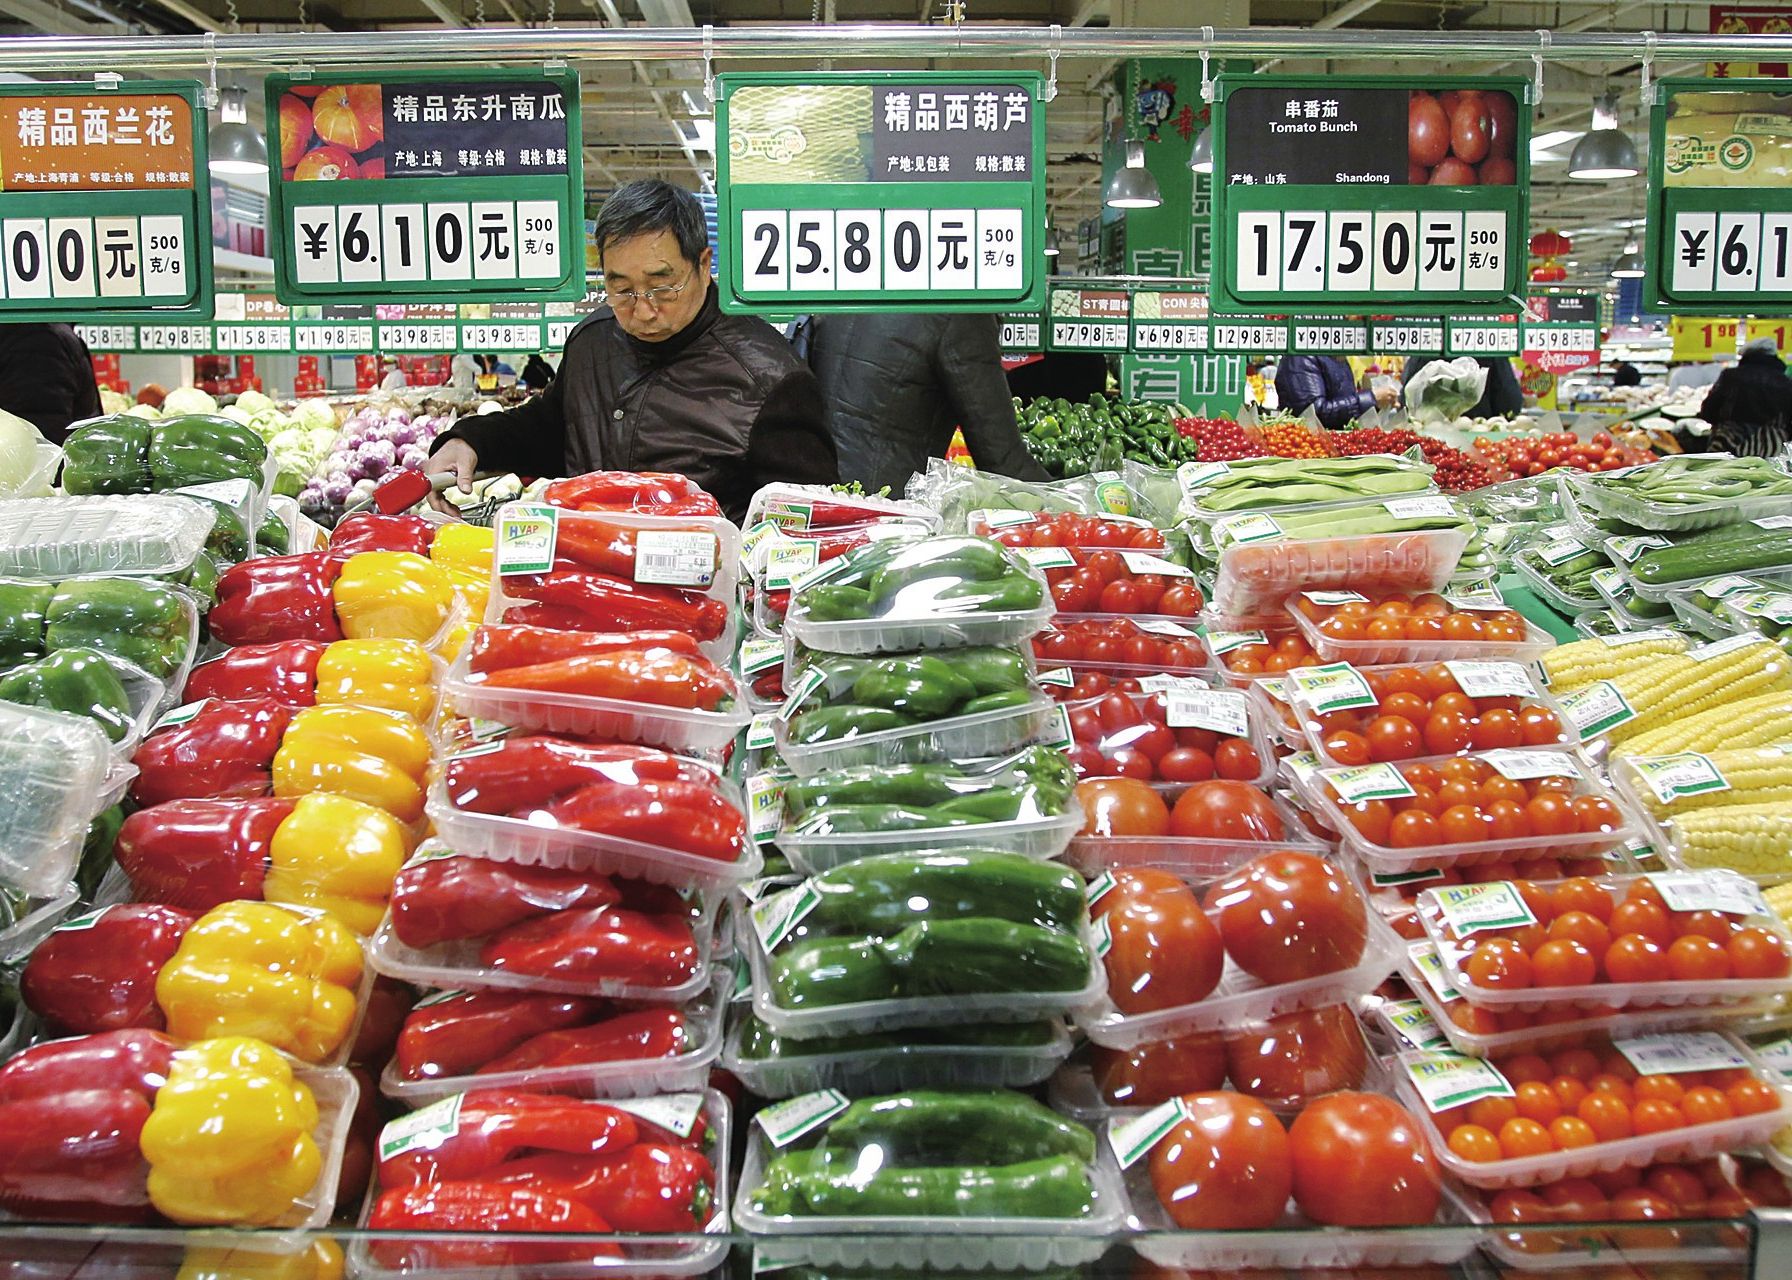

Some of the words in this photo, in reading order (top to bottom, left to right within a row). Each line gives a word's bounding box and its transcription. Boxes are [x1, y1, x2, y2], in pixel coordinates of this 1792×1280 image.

[393, 94, 566, 122] 精品东升南瓜
[884, 92, 1028, 132] 精品西葫芦
[1285, 100, 1339, 119] 串番茄
[18, 107, 175, 147] 精品西兰花
[1269, 122, 1317, 133] Tomato
[1320, 121, 1358, 133] Bunch
[1335, 172, 1390, 184] Shandong
[525, 218, 553, 232] 500
[150, 236, 178, 250] 500
[985, 228, 1014, 242] 500
[1470, 230, 1498, 245] 500
[525, 238, 554, 256] 克/g
[150, 257, 180, 274] 克/g
[984, 250, 1014, 267] 克/g
[1469, 252, 1498, 269] 克/g
[1163, 298, 1187, 308] CON
